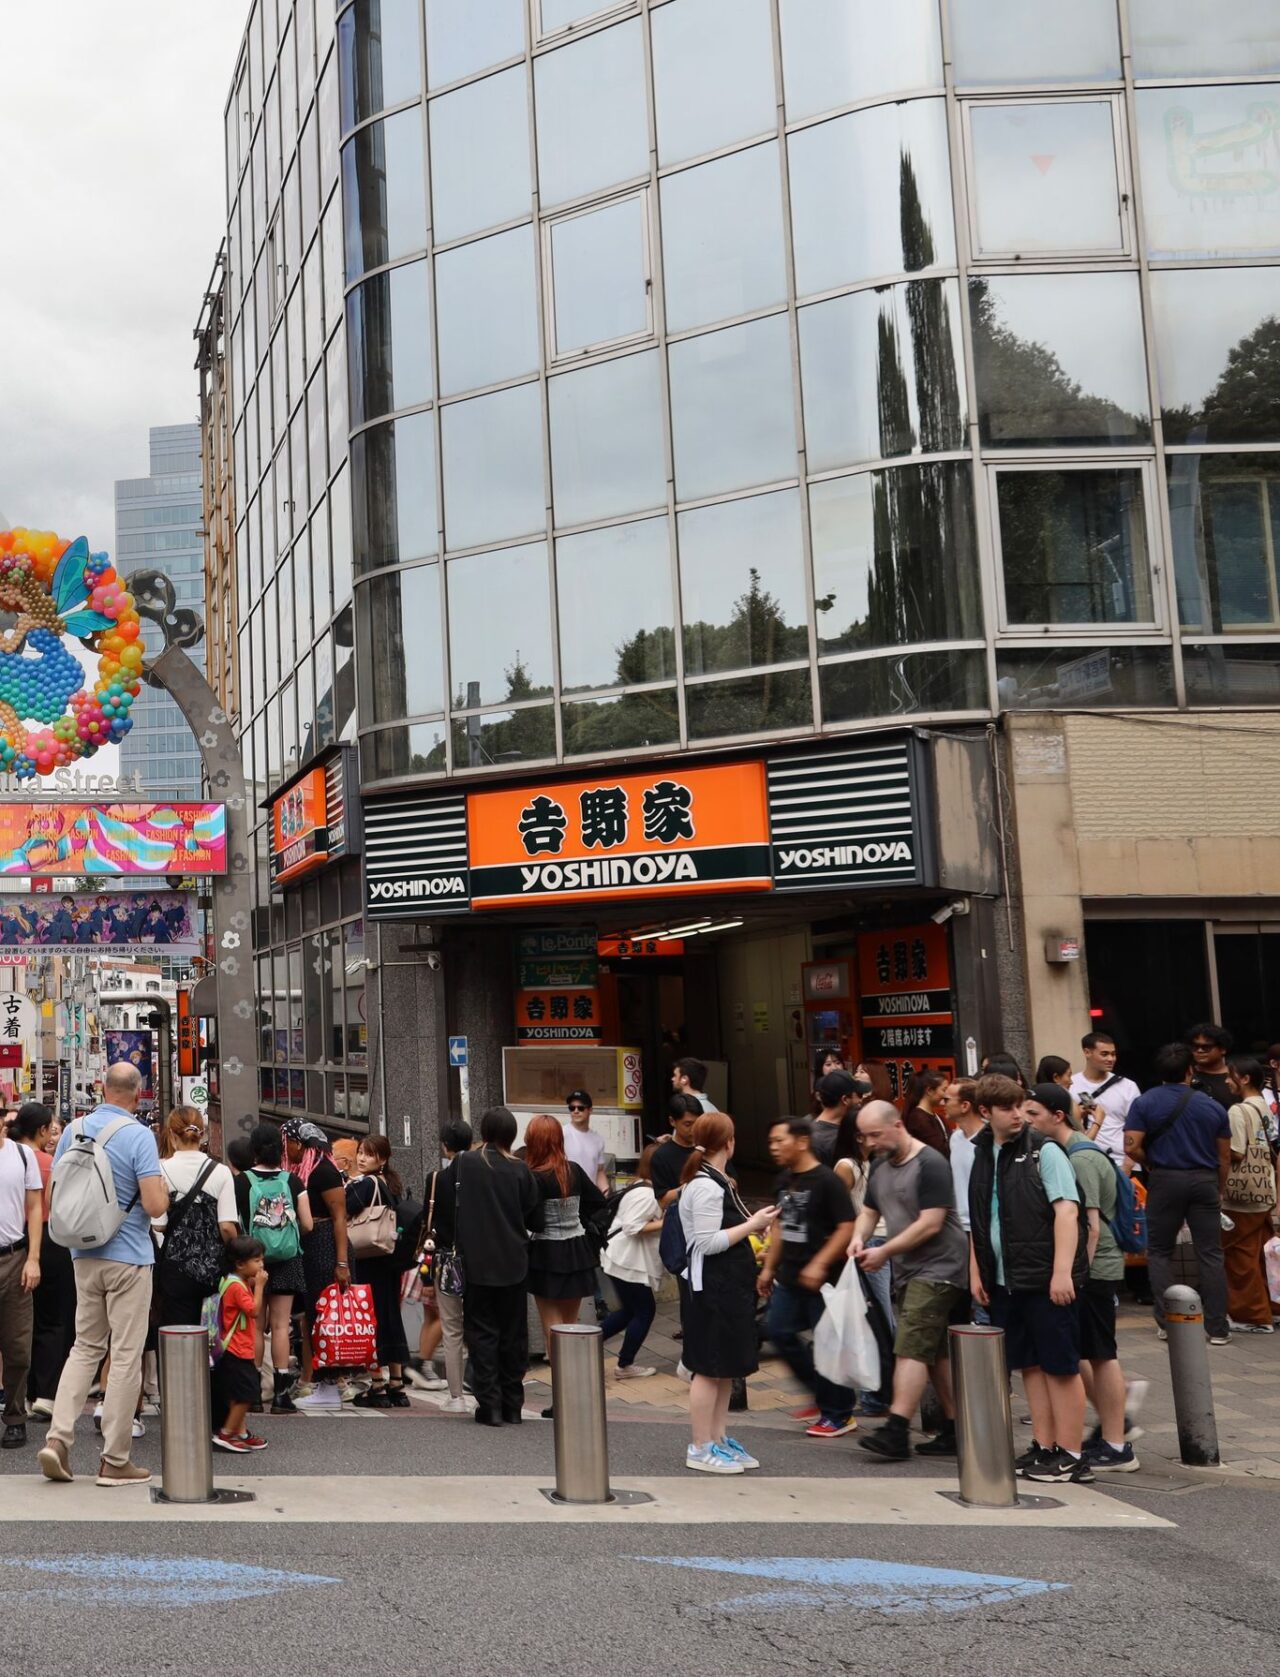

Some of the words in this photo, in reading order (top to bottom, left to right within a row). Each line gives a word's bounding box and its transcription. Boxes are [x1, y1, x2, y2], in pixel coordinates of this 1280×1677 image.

[55, 767, 145, 795] Street
[517, 780, 696, 856] 吉野家
[779, 842, 912, 870] YOSHINOYA
[521, 853, 698, 892] YOSHINOYA
[369, 876, 466, 901] YOSHINOYA
[877, 938, 928, 984] 吉野家
[3, 994, 22, 1038] 古着
[526, 995, 593, 1021] 吉野家
[878, 994, 930, 1013] YOSHINOYA
[527, 1027, 594, 1038] YOSHINOYA
[881, 1028, 932, 1047] 2階席あります
[320, 1323, 354, 1336] ACDC
[354, 1323, 376, 1335] RAG
